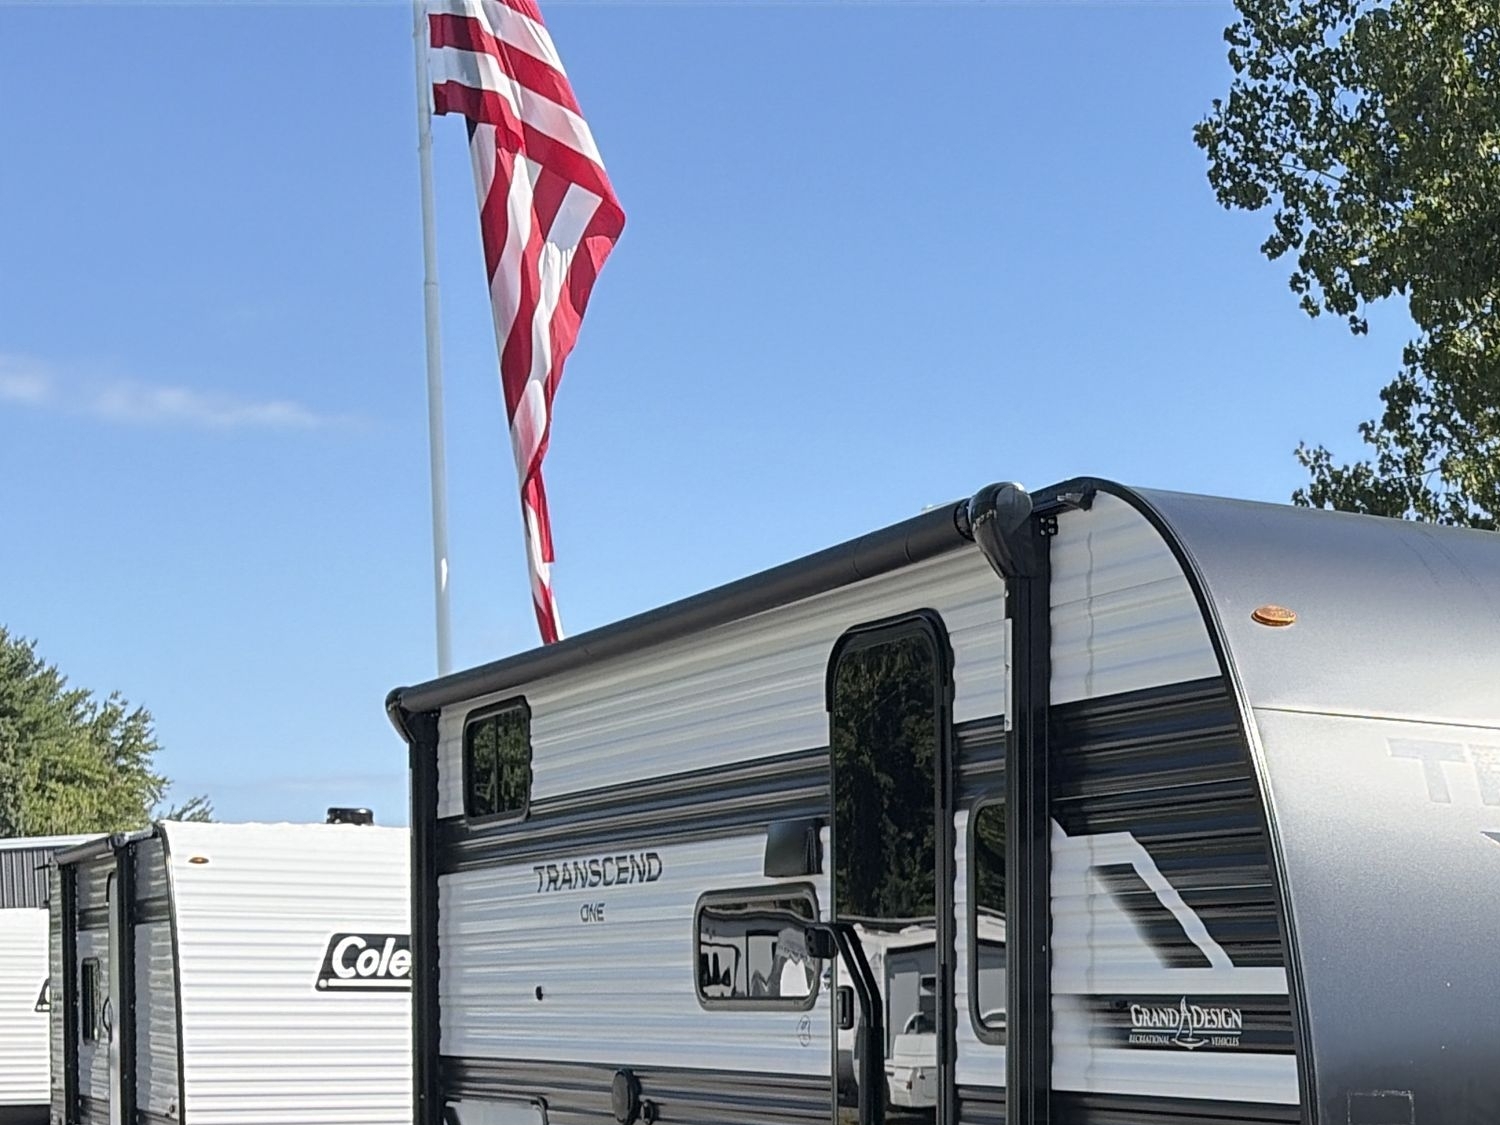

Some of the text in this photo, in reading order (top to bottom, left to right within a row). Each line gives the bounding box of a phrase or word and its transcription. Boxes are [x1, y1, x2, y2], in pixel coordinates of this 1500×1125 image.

[533, 852, 663, 893] TRANSCEND
[580, 903, 605, 923] ONE
[332, 935, 412, 979] Cole
[1131, 1004, 1243, 1029] GRAND DESIGN
[1129, 1034, 1240, 1047] RECREATIONAL VEHICLES
